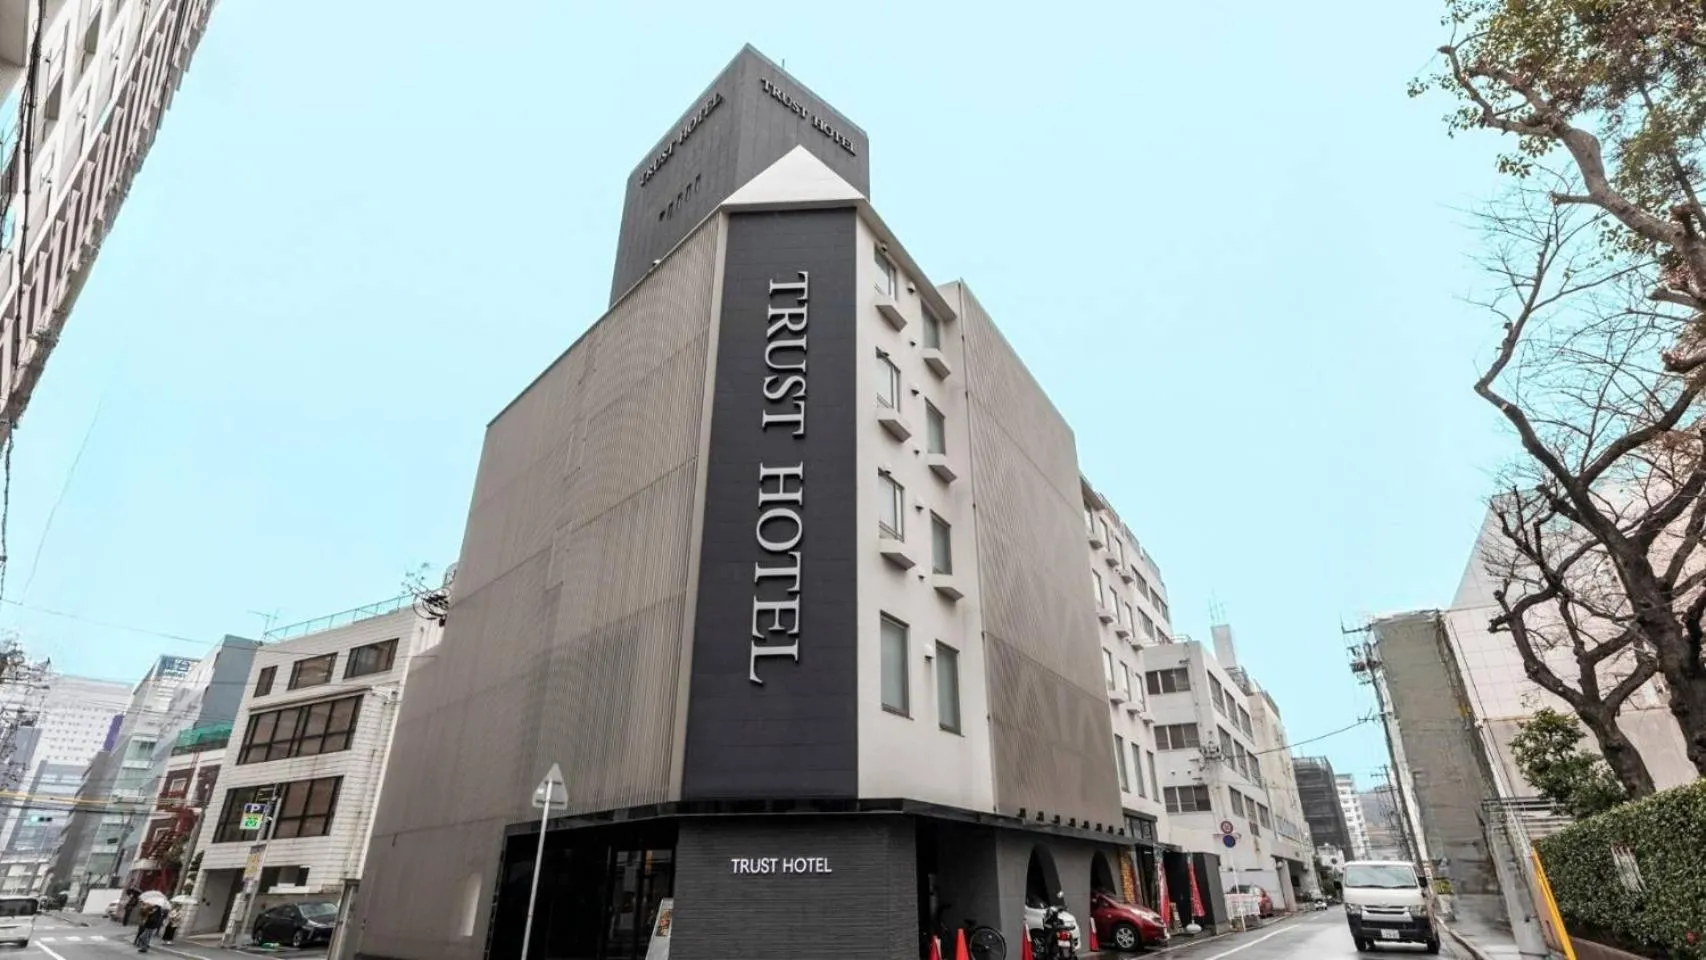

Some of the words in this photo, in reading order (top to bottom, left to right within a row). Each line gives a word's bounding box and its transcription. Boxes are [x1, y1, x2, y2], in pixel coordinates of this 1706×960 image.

[679, 93, 725, 145] HOTEL
[761, 77, 808, 119] TRUST
[812, 115, 856, 156] HOTEL
[762, 271, 808, 435] TRUST
[750, 461, 803, 684] HOTEL
[250, 803, 260, 813] P
[731, 857, 778, 873] TRUST
[783, 857, 832, 873] HOTEL
